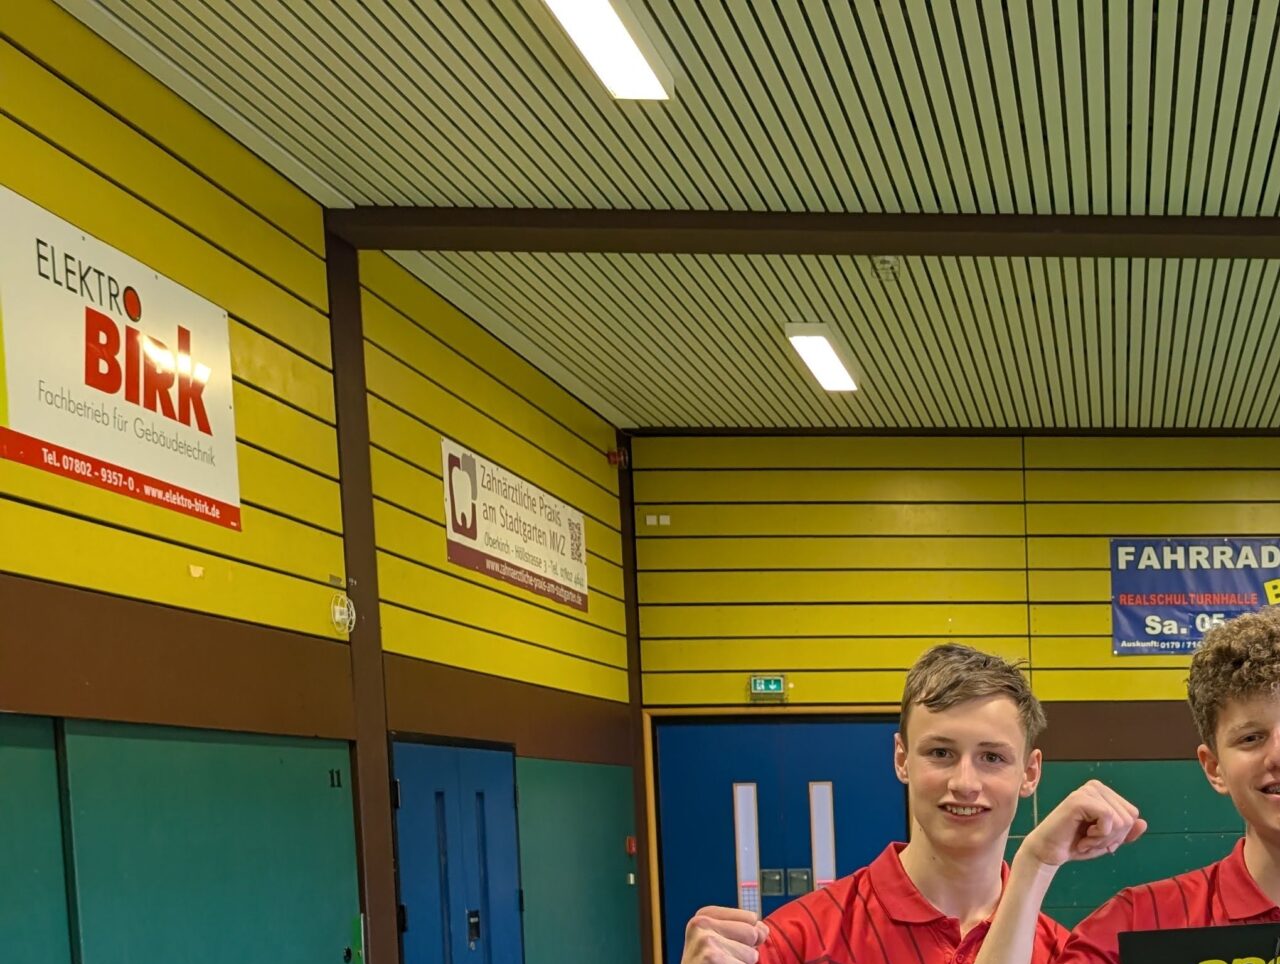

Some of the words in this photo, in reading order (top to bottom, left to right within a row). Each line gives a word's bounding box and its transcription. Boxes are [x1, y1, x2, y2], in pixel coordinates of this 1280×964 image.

[38, 380, 110, 426] Fachbetrieb
[113, 407, 128, 433] für
[133, 417, 216, 466] Gebäudetechnik
[42, 448, 60, 467] Tel.
[62, 455, 92, 477] 07802
[101, 468, 135, 491] 9357-0
[144, 484, 221, 519] www.elektro-birk.de
[480, 464, 537, 514] Zahnärztliche
[539, 495, 562, 528] Praxis
[482, 502, 497, 524] am
[499, 505, 547, 546] Stadtgarten
[1120, 640, 1160, 649] Auskunft:
[1160, 641, 1181, 649] 0179
[1145, 615, 1188, 635] Sa.
[328, 768, 342, 788] 11
